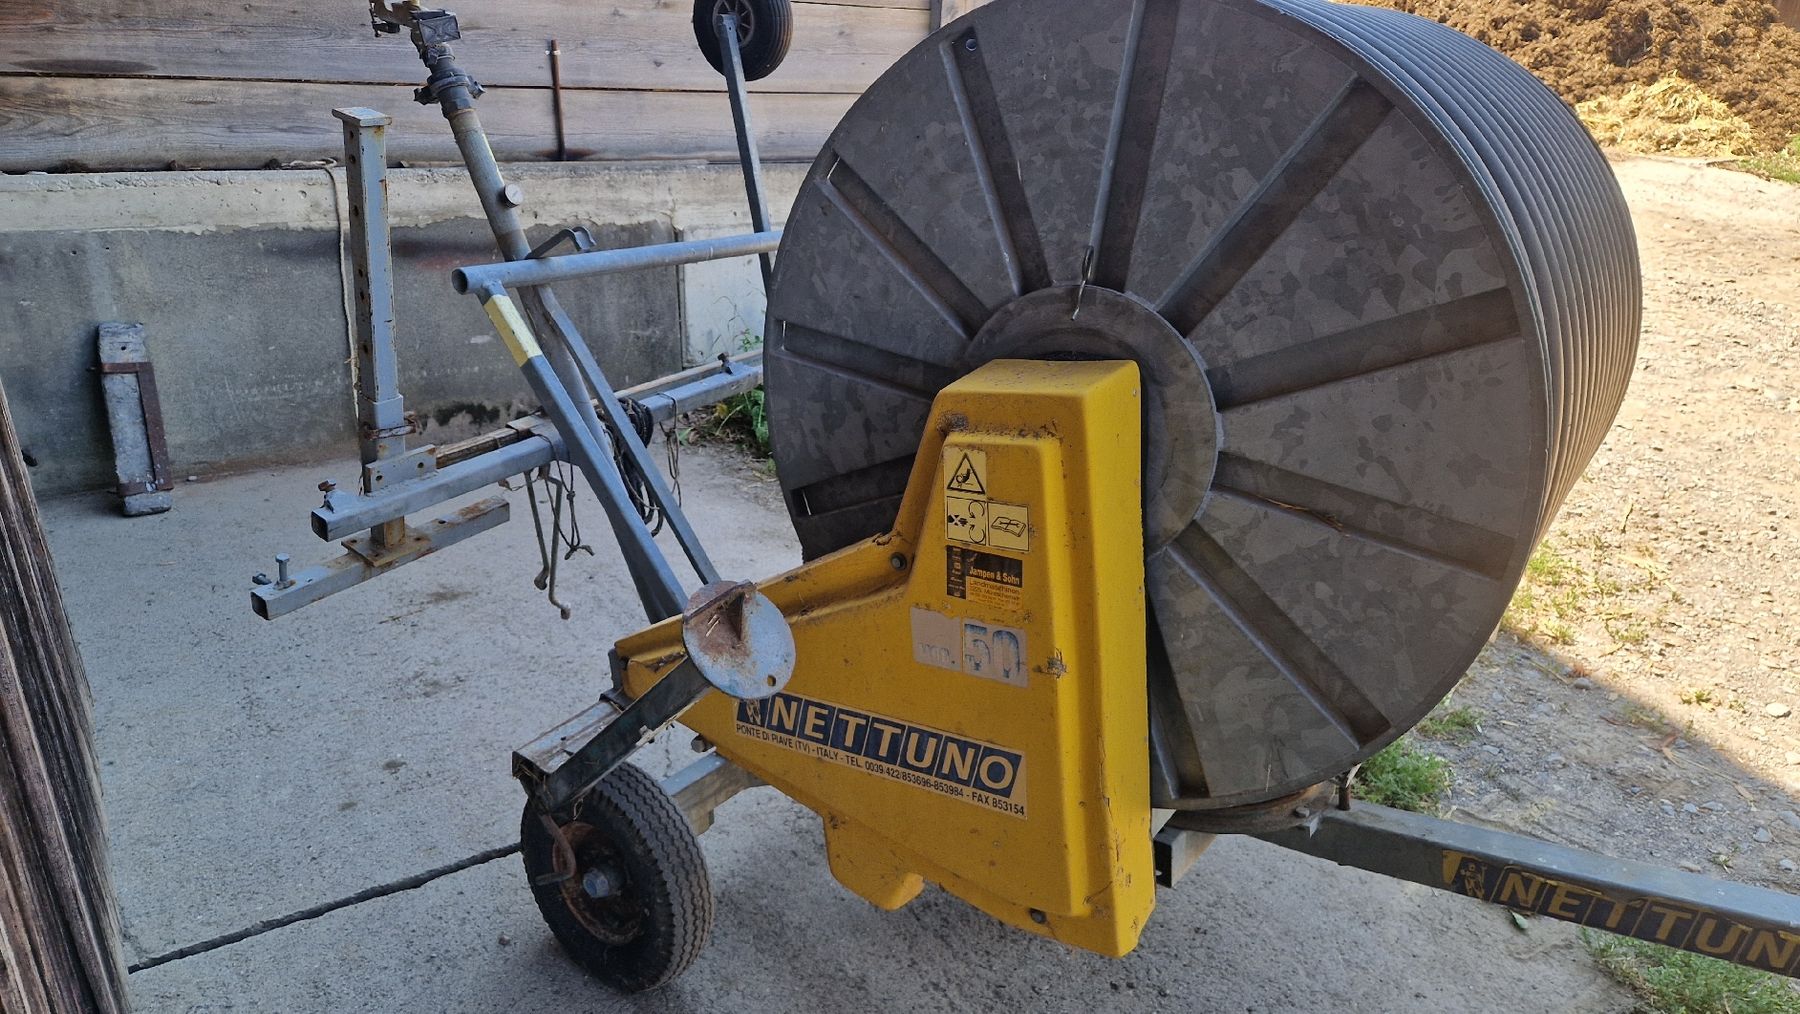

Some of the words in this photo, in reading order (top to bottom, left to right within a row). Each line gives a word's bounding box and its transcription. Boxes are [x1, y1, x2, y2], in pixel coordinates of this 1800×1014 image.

[969, 566, 995, 580] Jampen
[996, 570, 1001, 581] &
[1002, 572, 1020, 585] Sohn
[964, 623, 1021, 679] 50
[736, 723, 761, 739] PONTE
[771, 733, 793, 749] PIAVE
[795, 740, 811, 754] (TV)
[816, 746, 839, 761] ITALY
[845, 754, 864, 768] TEL.
[971, 791, 990, 806] FAX
[992, 797, 1025, 816] 853154
[771, 696, 1014, 790] NETTUNO
